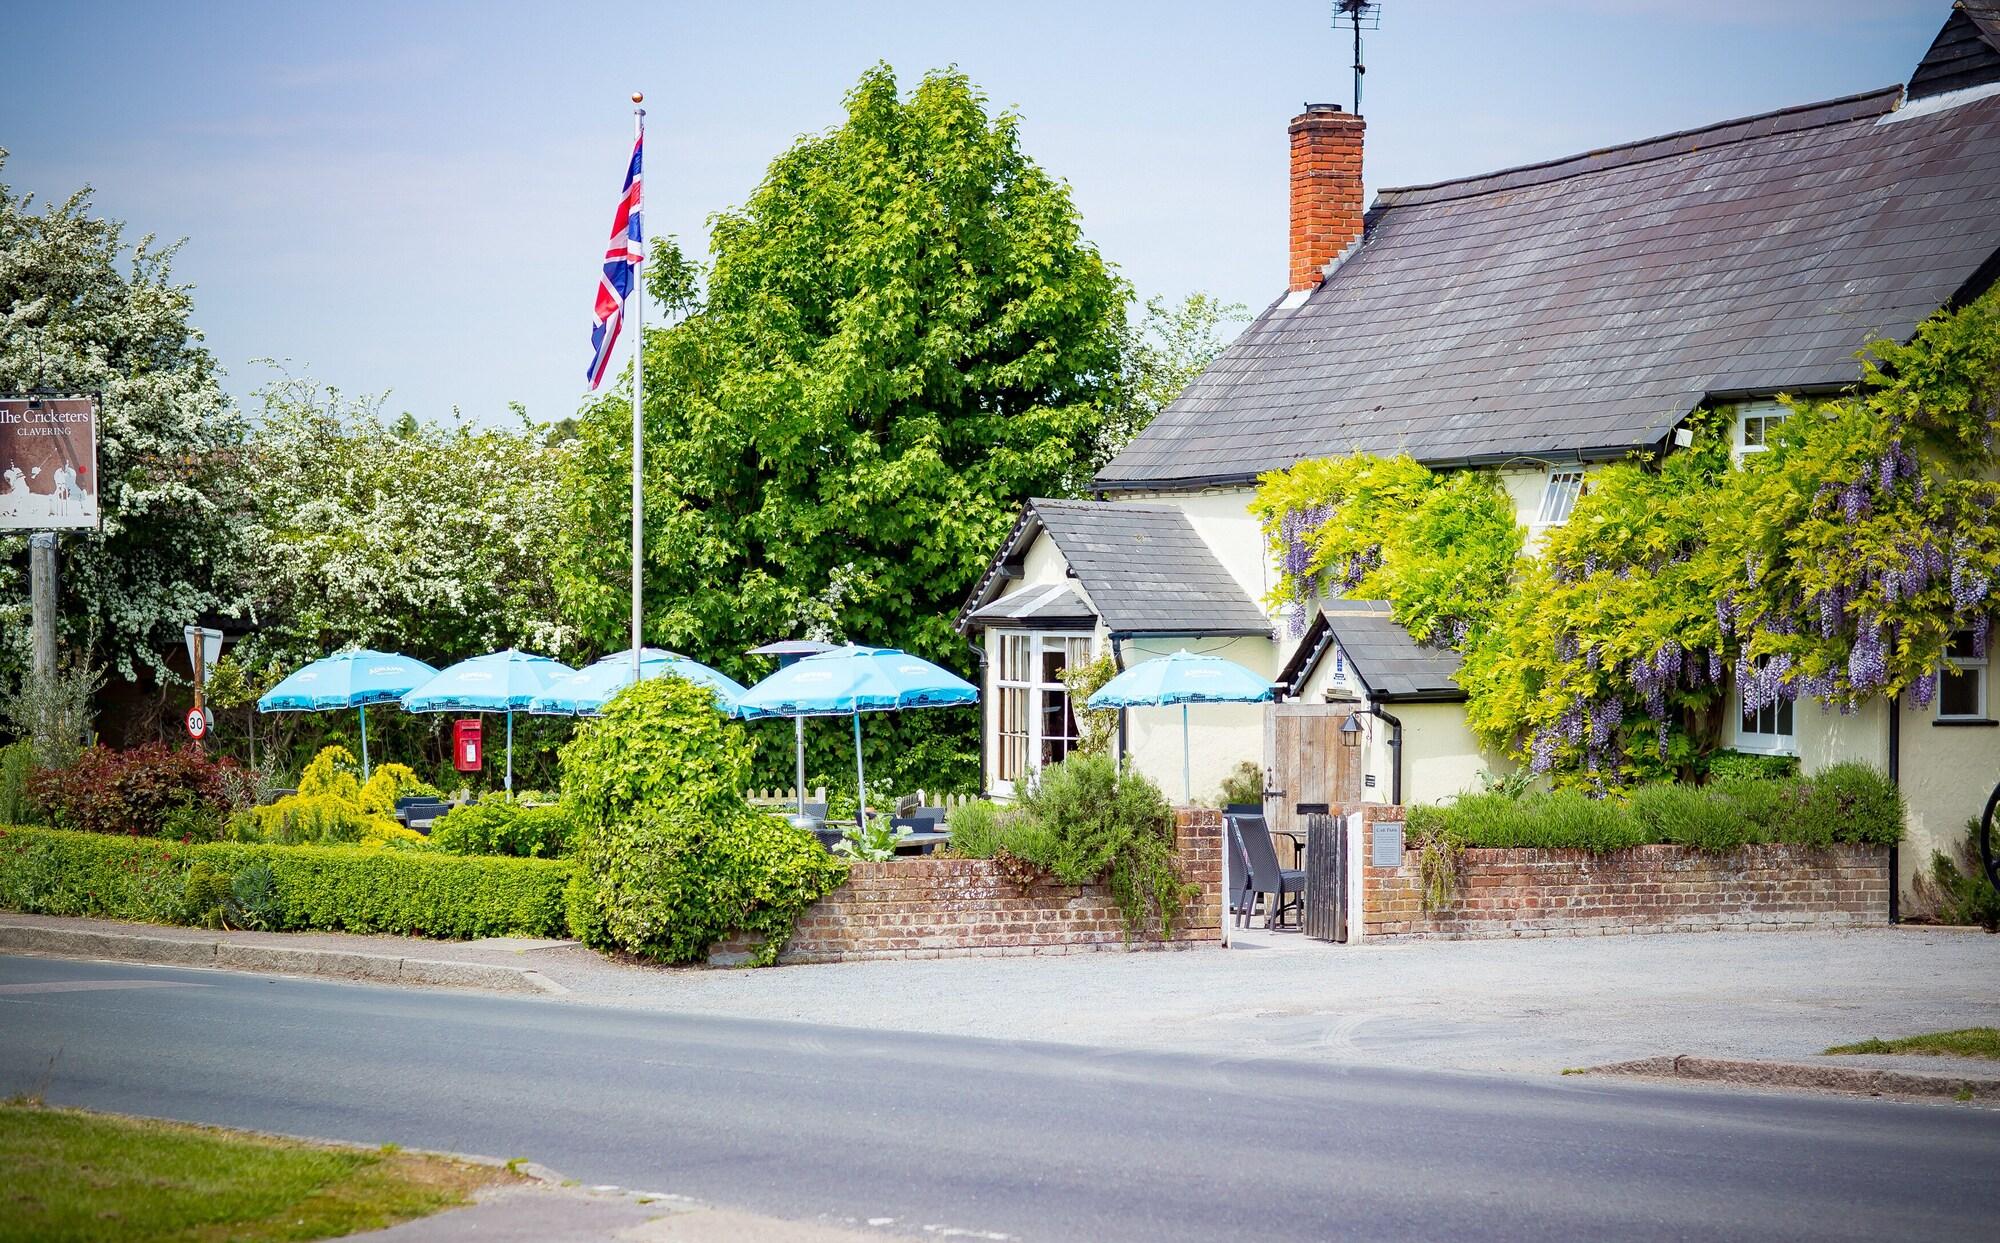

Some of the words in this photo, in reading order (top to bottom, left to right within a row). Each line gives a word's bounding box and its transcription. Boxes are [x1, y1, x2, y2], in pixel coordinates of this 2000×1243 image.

[0, 409, 21, 423] The
[23, 409, 89, 423] Cricketers
[17, 427, 72, 436] CLAVERING
[190, 717, 203, 729] 30
